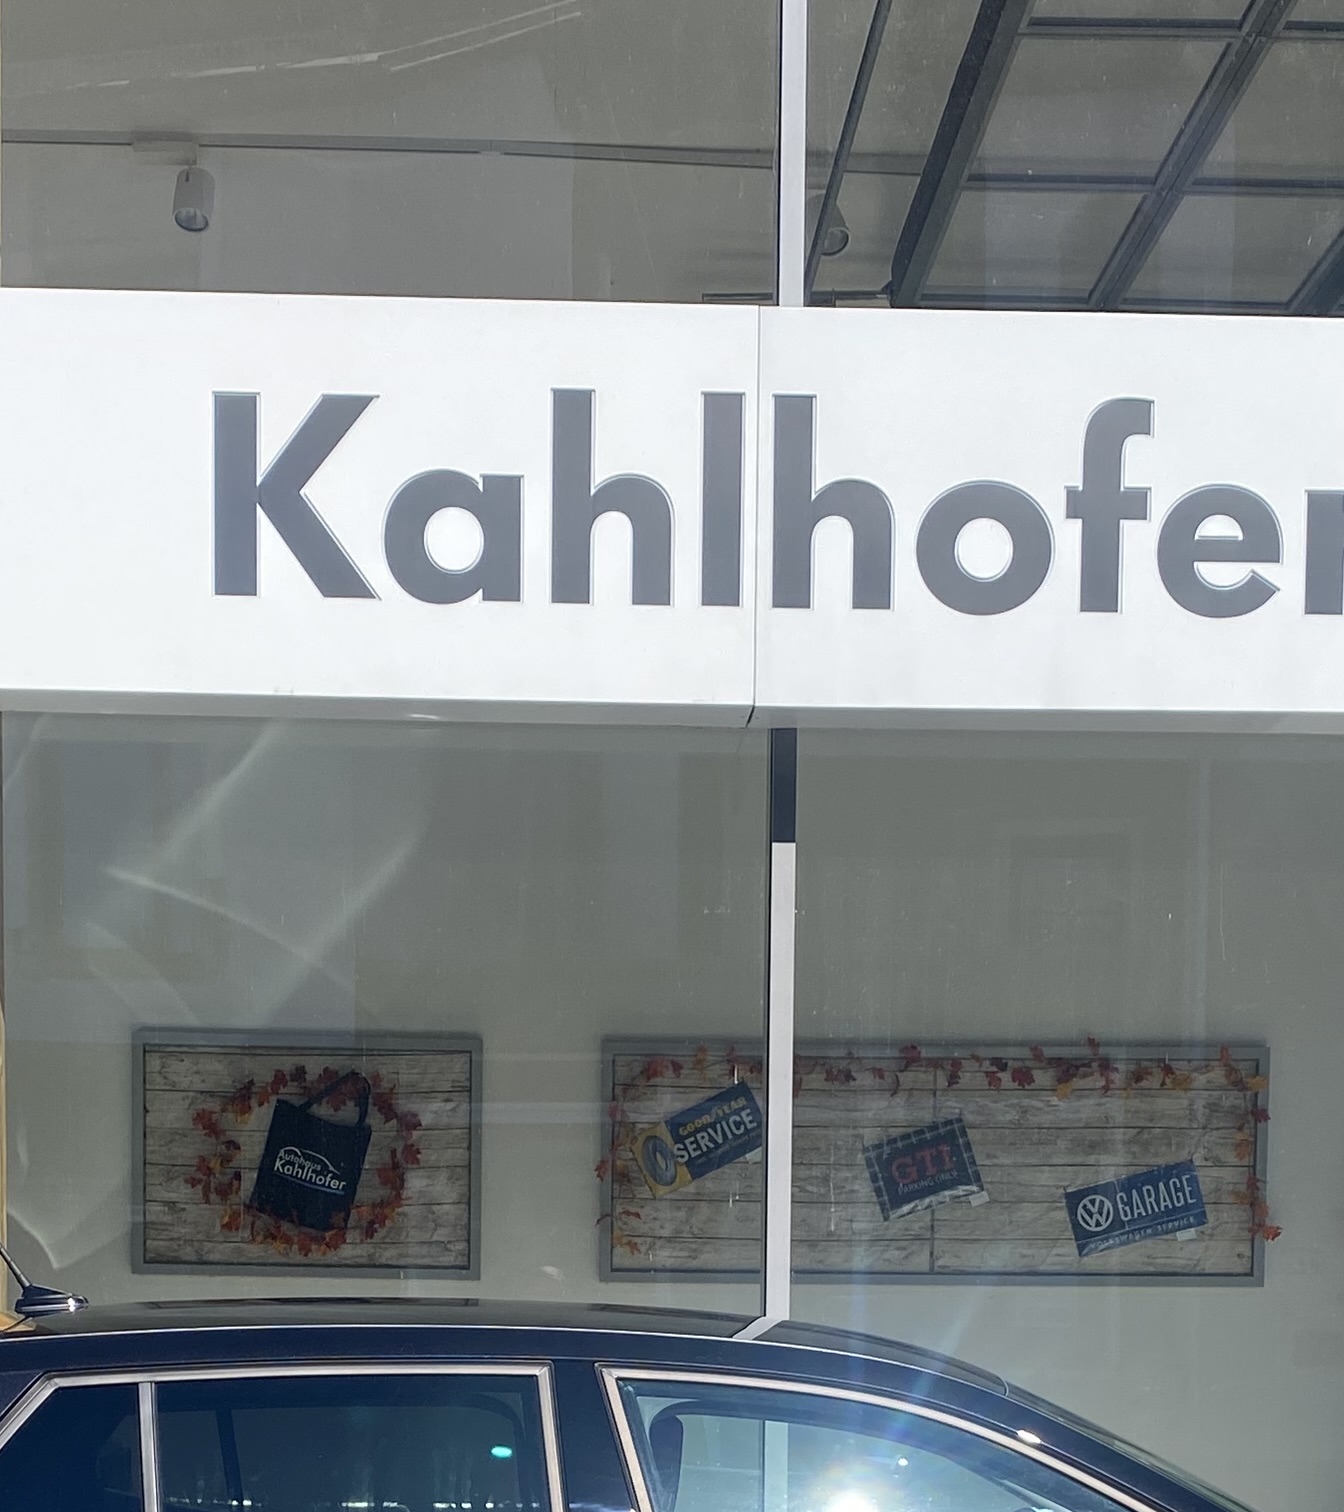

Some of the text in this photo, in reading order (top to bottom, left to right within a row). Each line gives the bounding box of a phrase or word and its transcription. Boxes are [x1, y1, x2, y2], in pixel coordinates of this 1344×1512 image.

[674, 1108, 757, 1163] SERVICE
[274, 1158, 346, 1190] Kahlhofer
[278, 1150, 322, 1171] Autohaus
[892, 1144, 954, 1184] GTI
[898, 1177, 935, 1195] PARKING
[1116, 1175, 1196, 1221] GARAGE
